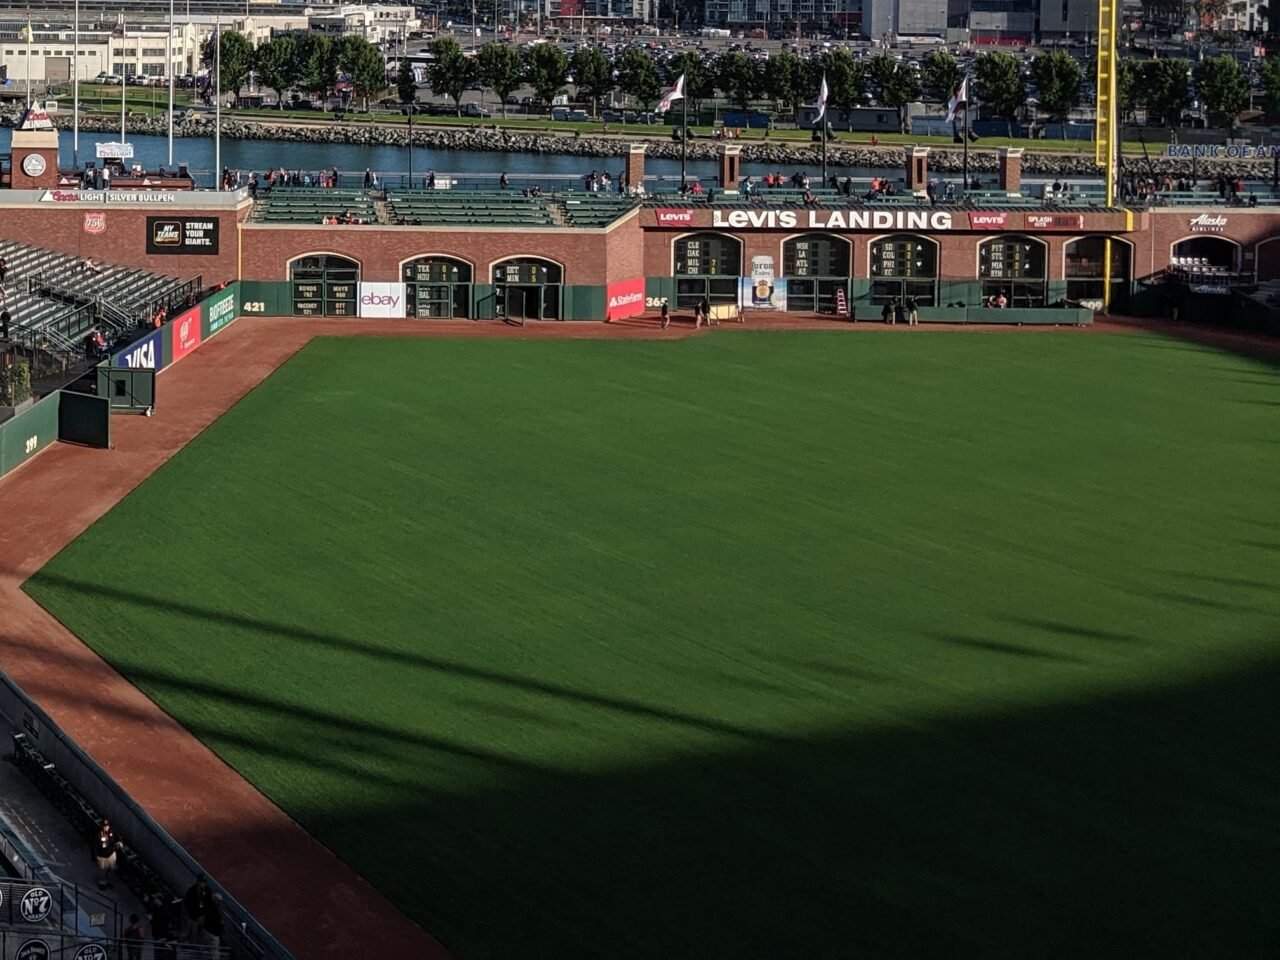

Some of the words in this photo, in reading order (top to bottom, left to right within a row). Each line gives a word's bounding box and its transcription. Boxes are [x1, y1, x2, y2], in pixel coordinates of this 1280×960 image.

[1167, 143, 1220, 158] BANK
[1226, 144, 1250, 158] OF
[51, 190, 80, 202] Coors
[80, 191, 104, 202] LIGHT
[109, 192, 138, 203] SILVER
[138, 192, 175, 204] BULLPEN
[185, 222, 214, 230] STREAM
[808, 211, 953, 230] LANDING
[1190, 214, 1228, 227] Alaska
[185, 230, 204, 238] YOUR
[417, 264, 430, 273] TEX
[361, 291, 400, 309] ebay
[244, 302, 265, 312] 421
[125, 339, 155, 369] VISA
[25, 435, 38, 454] 399
[30, 890, 43, 898] OLD
